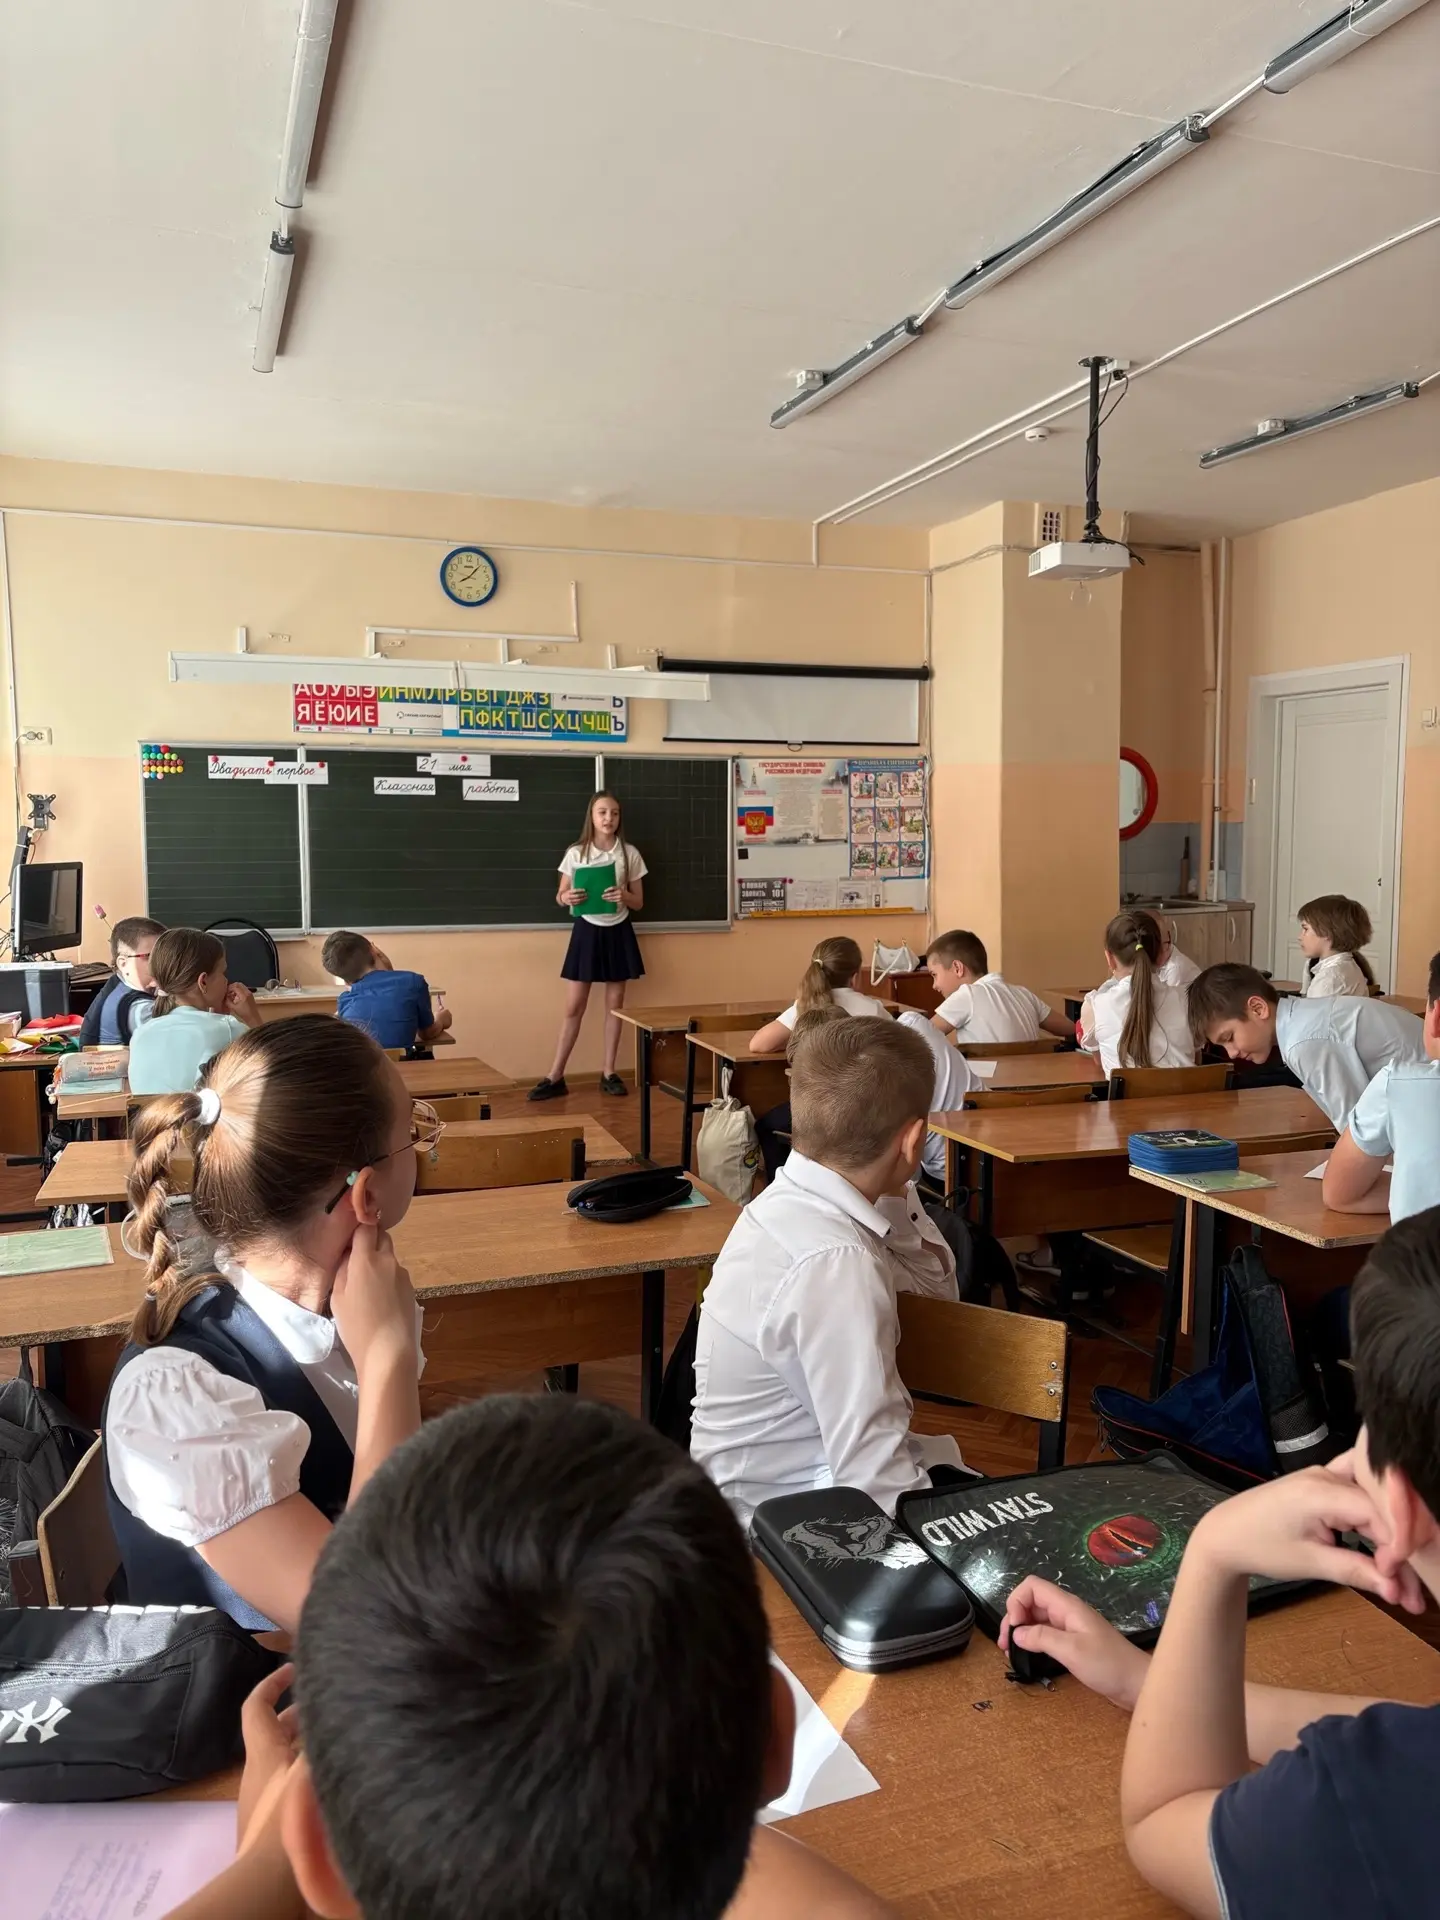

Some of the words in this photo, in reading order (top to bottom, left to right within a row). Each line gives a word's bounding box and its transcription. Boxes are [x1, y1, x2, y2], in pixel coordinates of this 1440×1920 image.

[209, 761, 273, 779] Двадцать
[276, 763, 316, 779] первое
[418, 757, 438, 770] 21
[448, 763, 473, 772] мая
[375, 779, 435, 792] Классная
[772, 889, 784, 898] 101
[986, 1492, 1054, 1525] STAY
[921, 1509, 999, 1547] WILD
